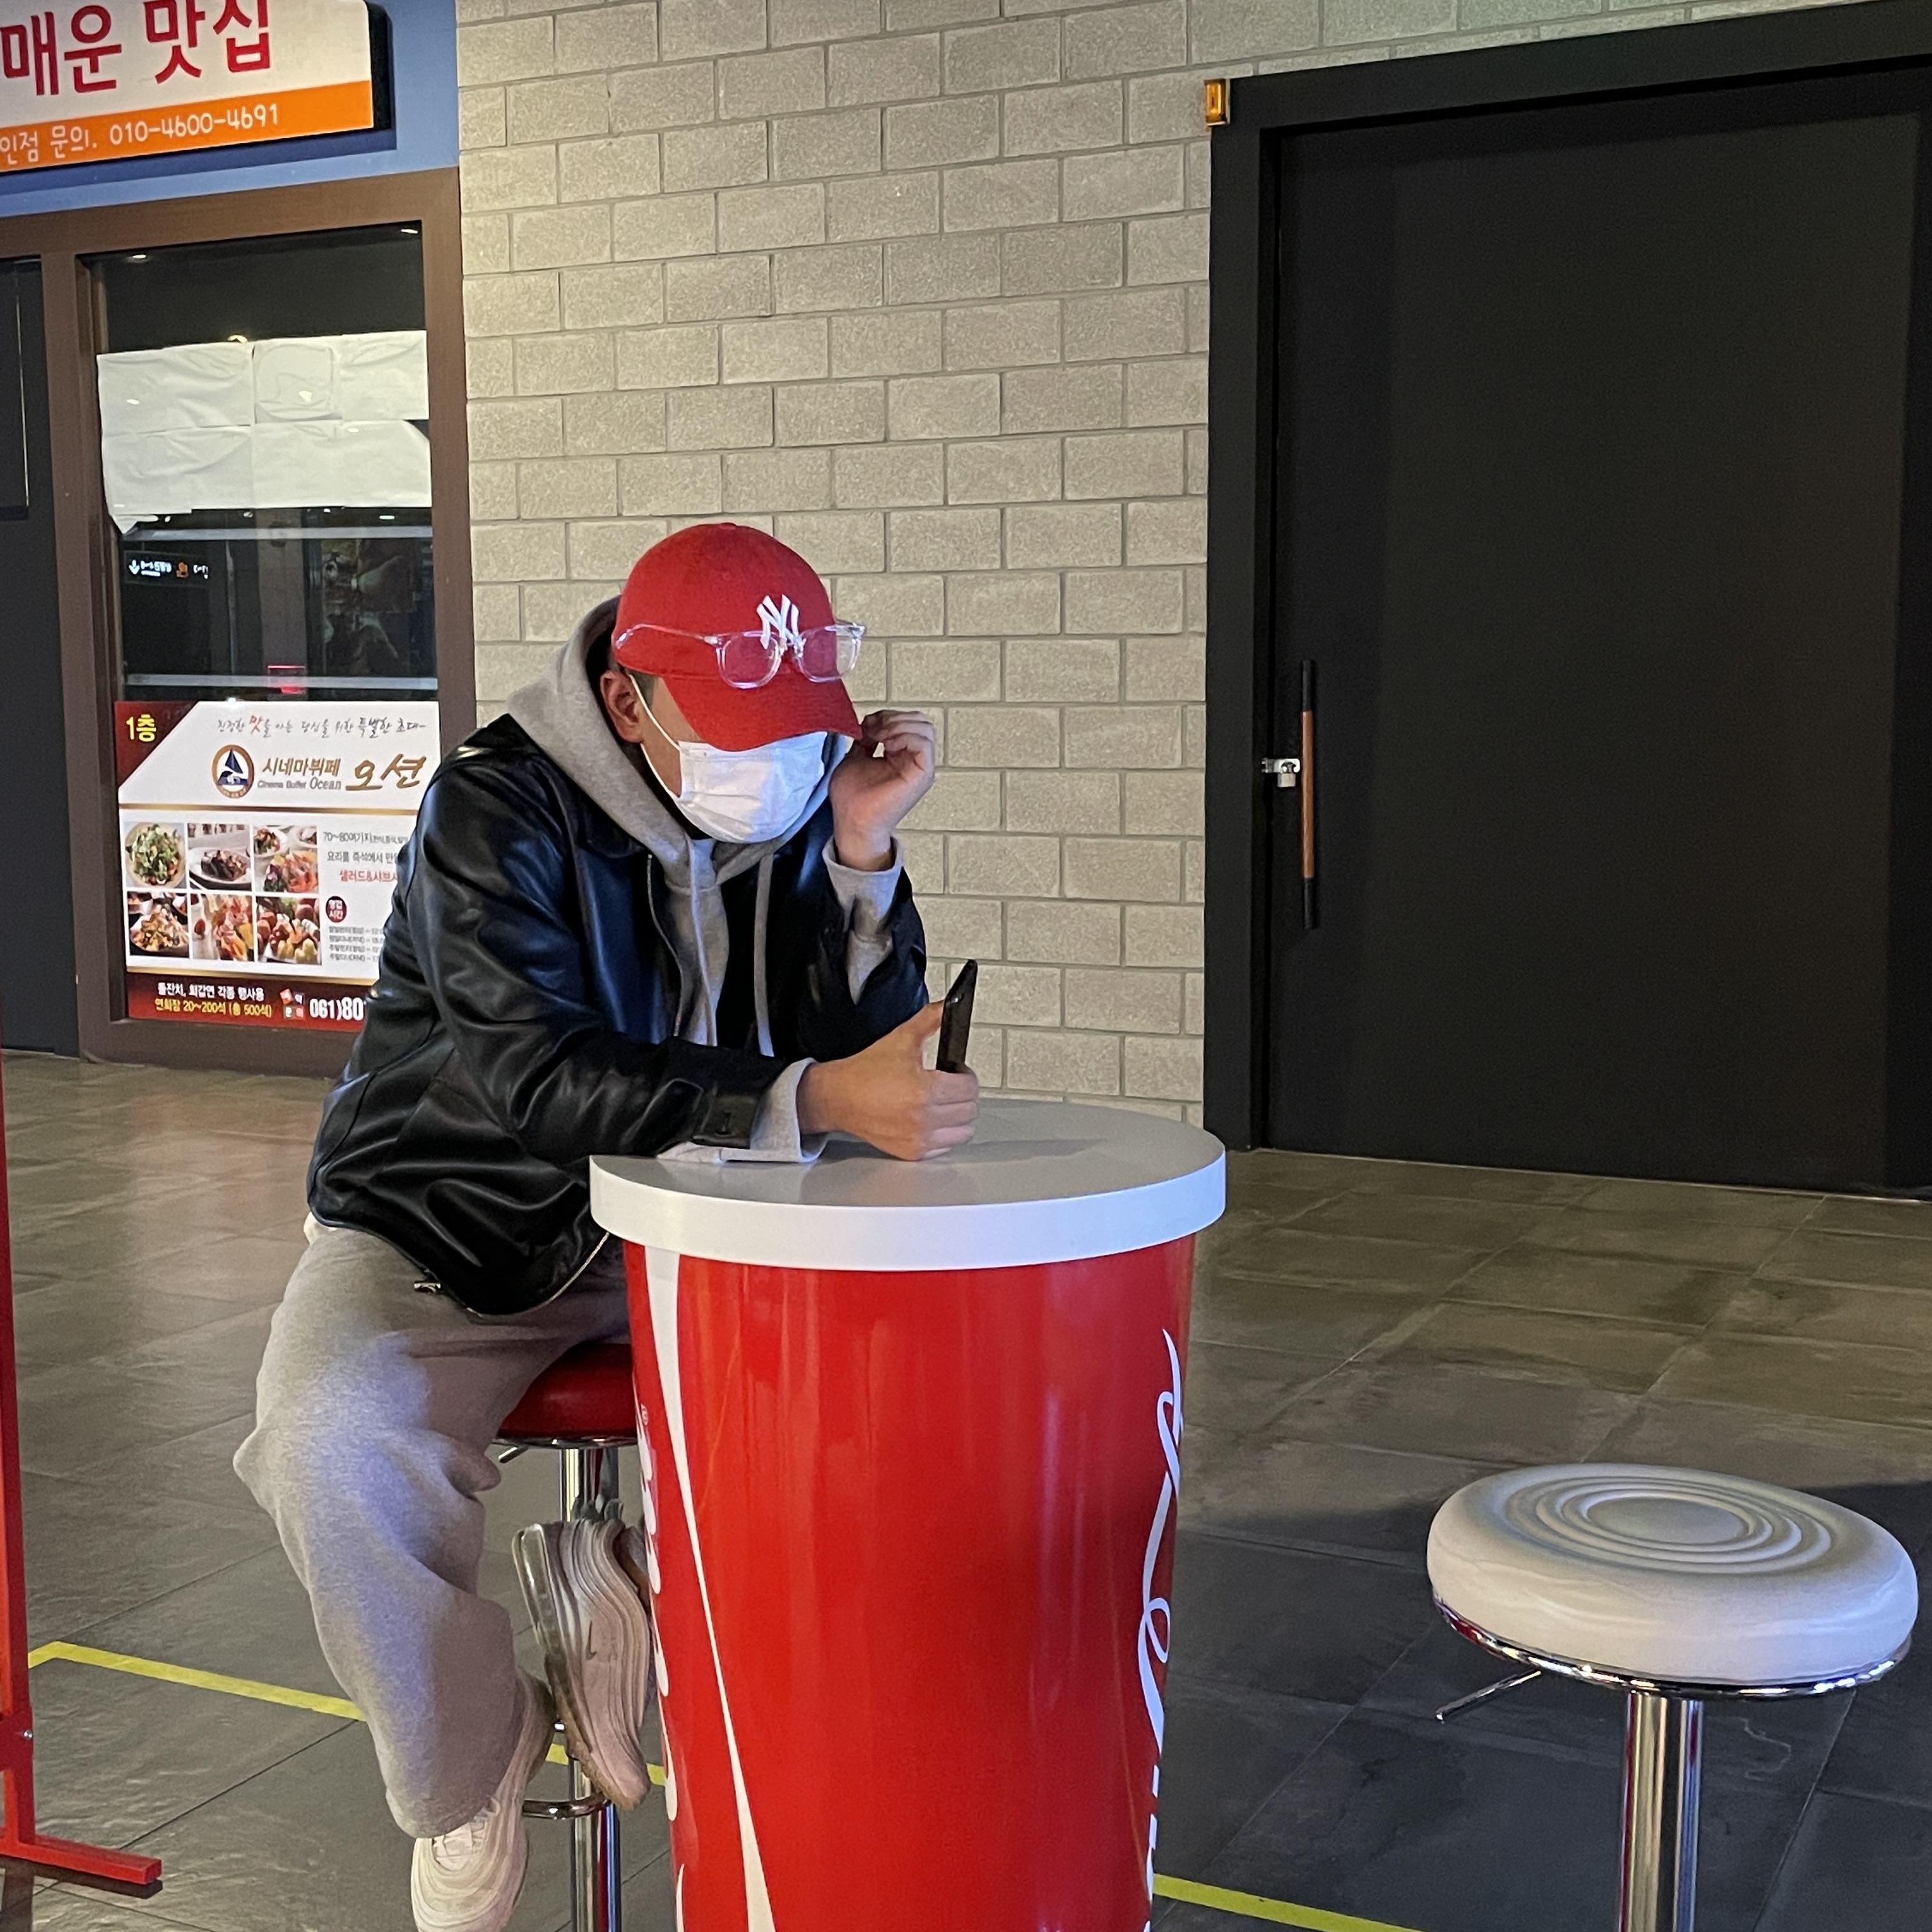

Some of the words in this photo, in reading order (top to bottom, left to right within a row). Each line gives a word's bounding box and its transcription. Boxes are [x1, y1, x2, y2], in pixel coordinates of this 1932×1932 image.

[0, 12, 122, 95] 매운
[0, 130, 38, 165] 인점
[50, 125, 97, 158] 문의.
[110, 103, 277, 145] 010-4600-4691
[756, 594, 805, 651] NY
[126, 714, 157, 742] 1층
[249, 715, 271, 738] 맛을
[335, 717, 354, 733] 위한
[358, 716, 392, 739] 특별한
[262, 757, 341, 776] 시네마뷔페
[346, 753, 426, 791] 오션
[310, 776, 341, 790] Ocean
[309, 997, 366, 1021] 061)80
